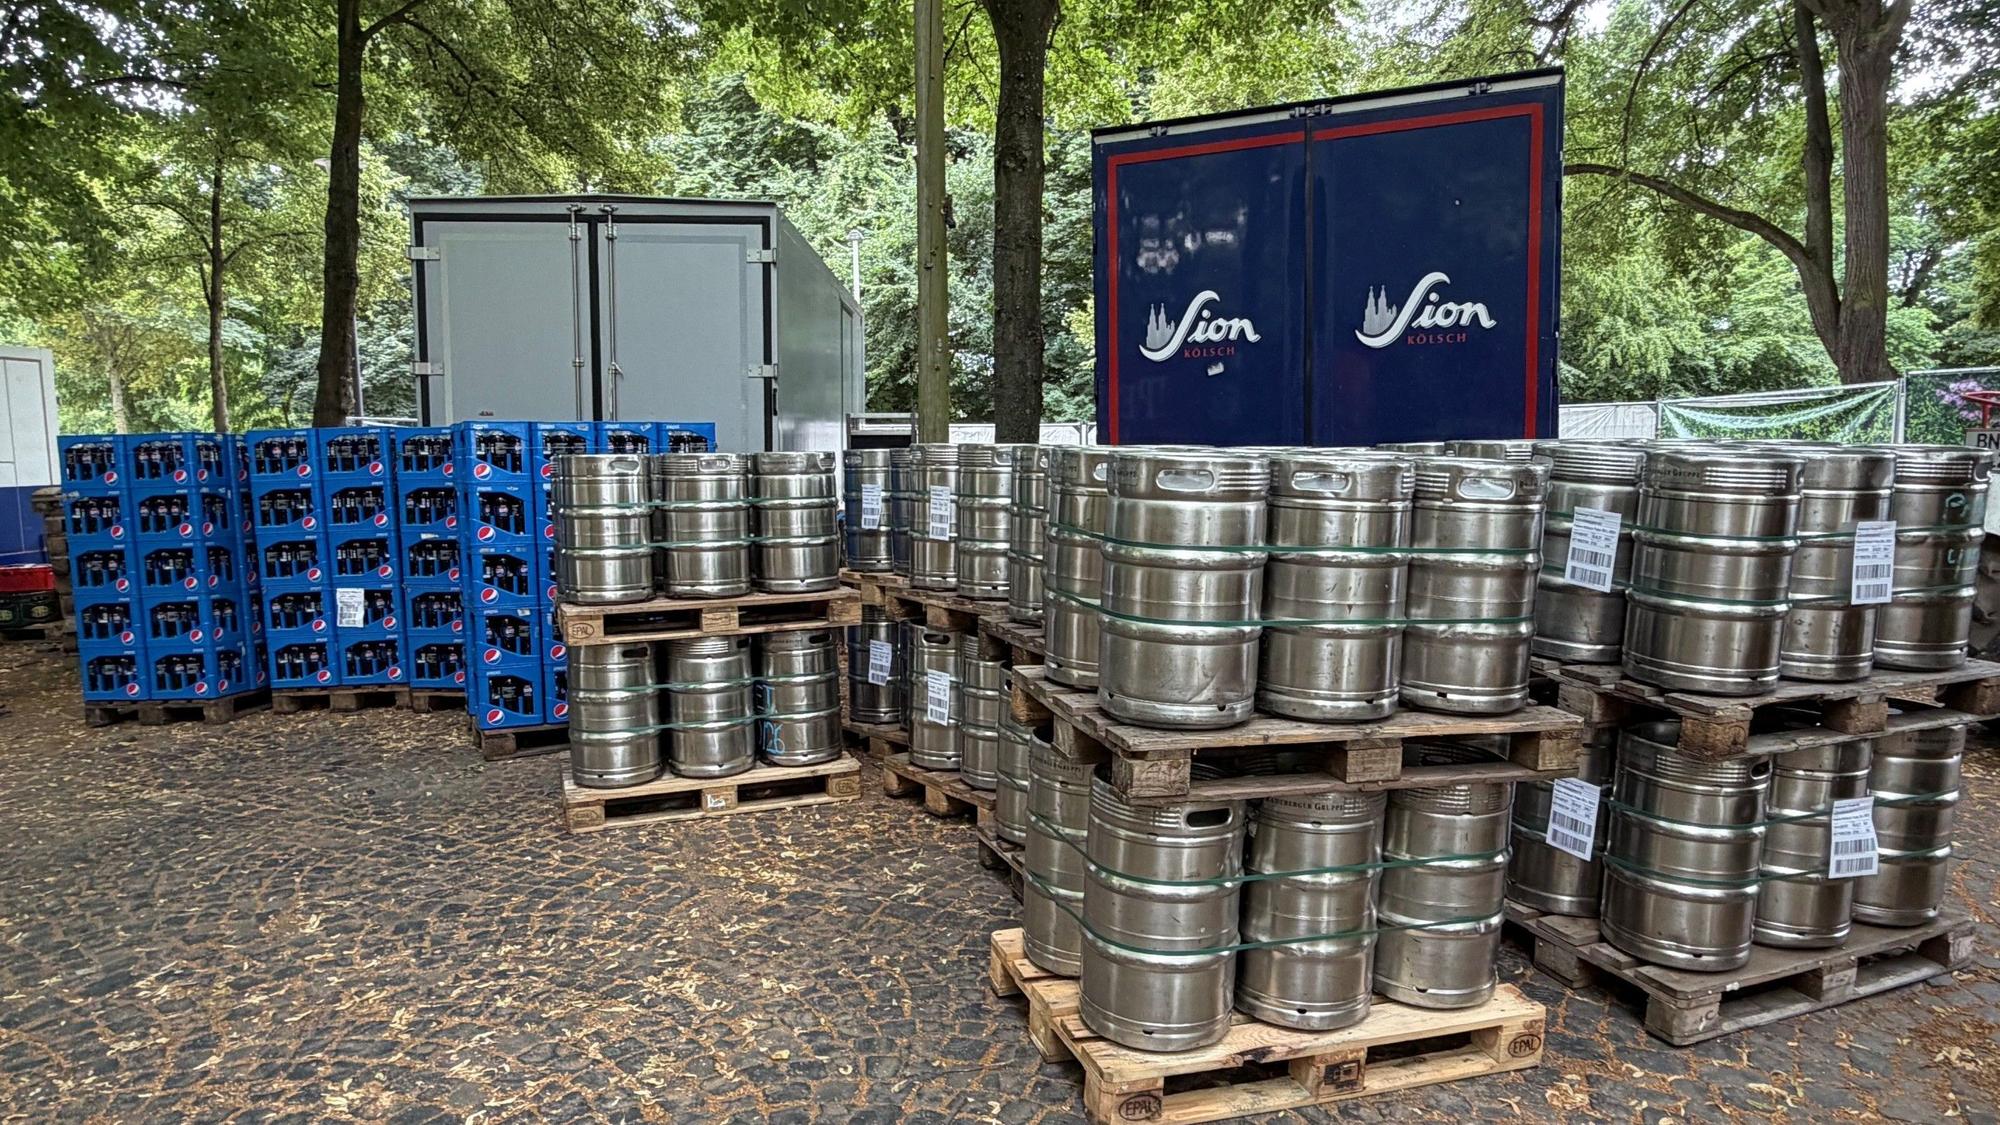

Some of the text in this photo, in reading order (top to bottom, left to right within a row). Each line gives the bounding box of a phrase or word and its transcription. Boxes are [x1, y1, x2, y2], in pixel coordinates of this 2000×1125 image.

[1355, 271, 1497, 348] Sion
[1139, 290, 1262, 362] Sion
[1407, 333, 1467, 345] KÖLSCH
[1183, 346, 1235, 358] KÖLSCH
[1977, 433, 2000, 449] BN
[1513, 1038, 1536, 1054] EPAL
